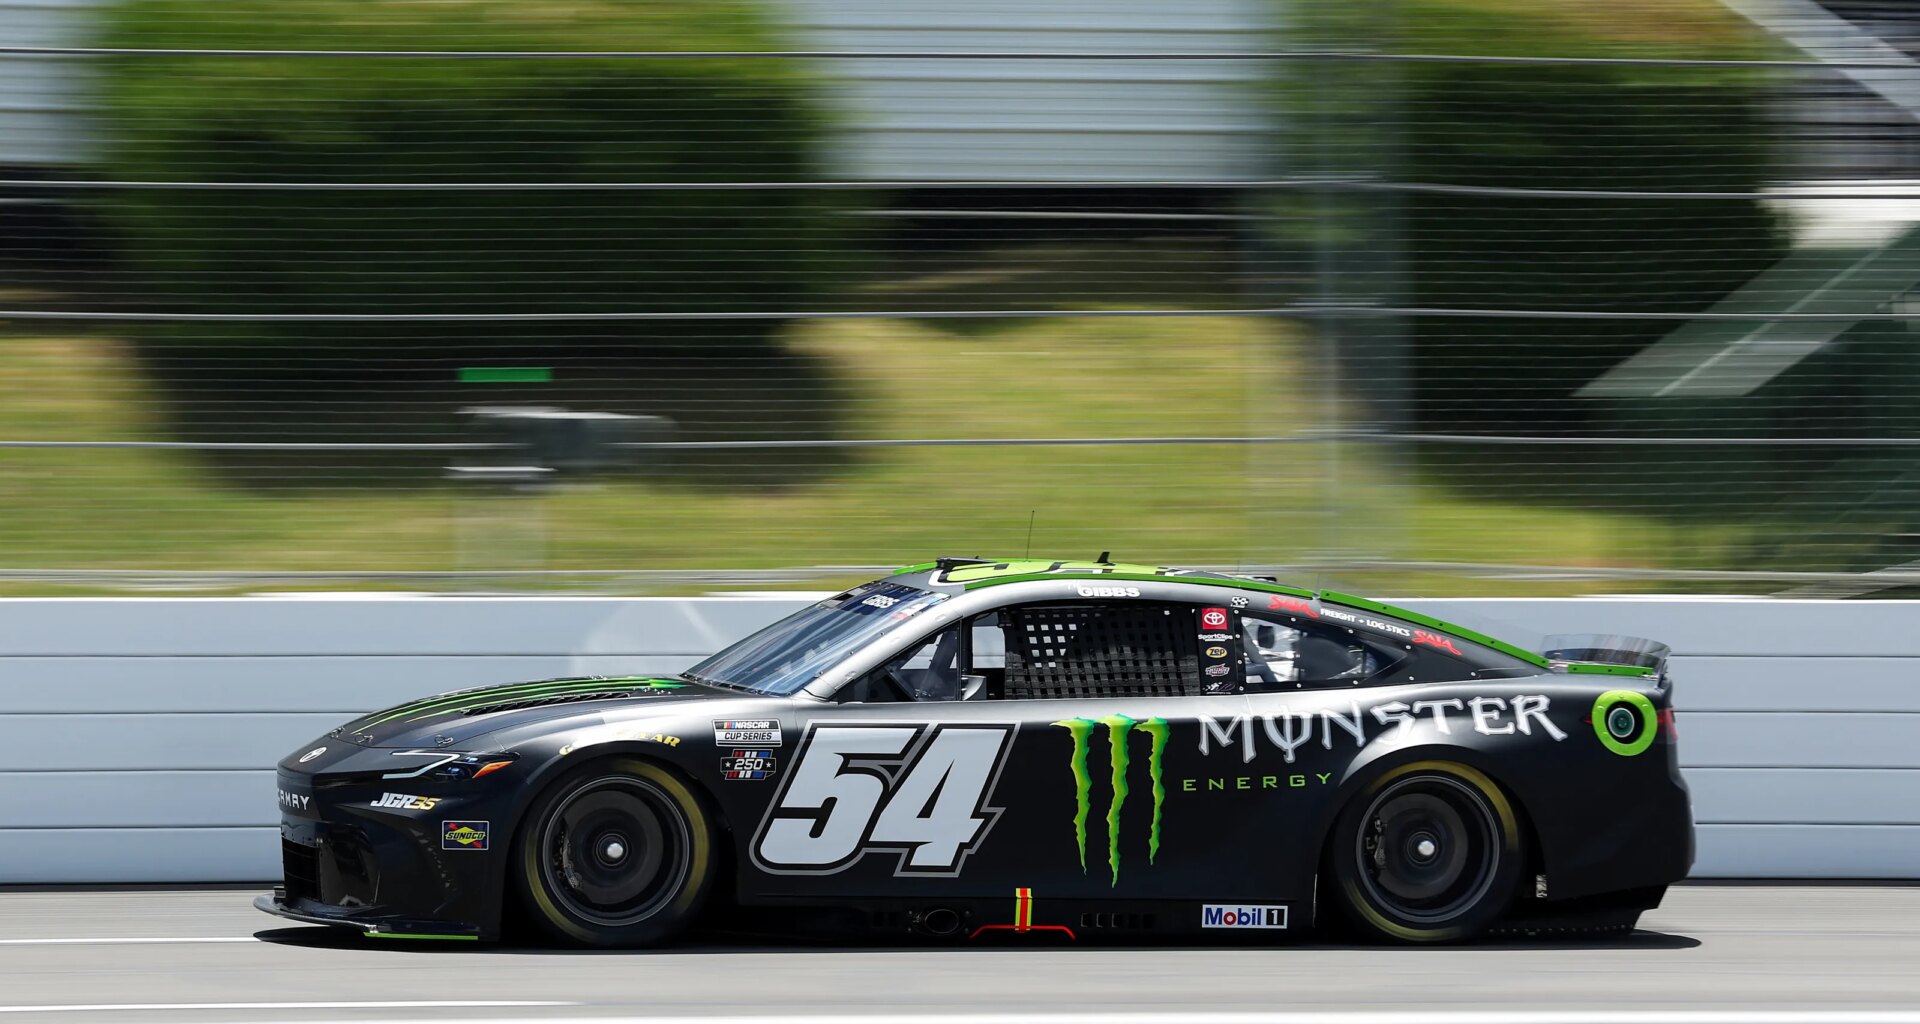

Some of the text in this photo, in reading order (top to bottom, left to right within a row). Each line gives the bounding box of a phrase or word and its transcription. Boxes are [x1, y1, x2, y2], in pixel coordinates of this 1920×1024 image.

[1078, 586, 1140, 597] GIBBS
[1320, 608, 1356, 623] FREIGHT
[735, 721, 769, 729] NASCAR
[725, 732, 772, 740] CUP SERIES
[733, 758, 764, 770] 250
[1183, 772, 1332, 791] ENERGY
[749, 719, 1021, 878] 54
[446, 832, 486, 840] SUNOCO
[1205, 908, 1279, 926] Mobil 1
